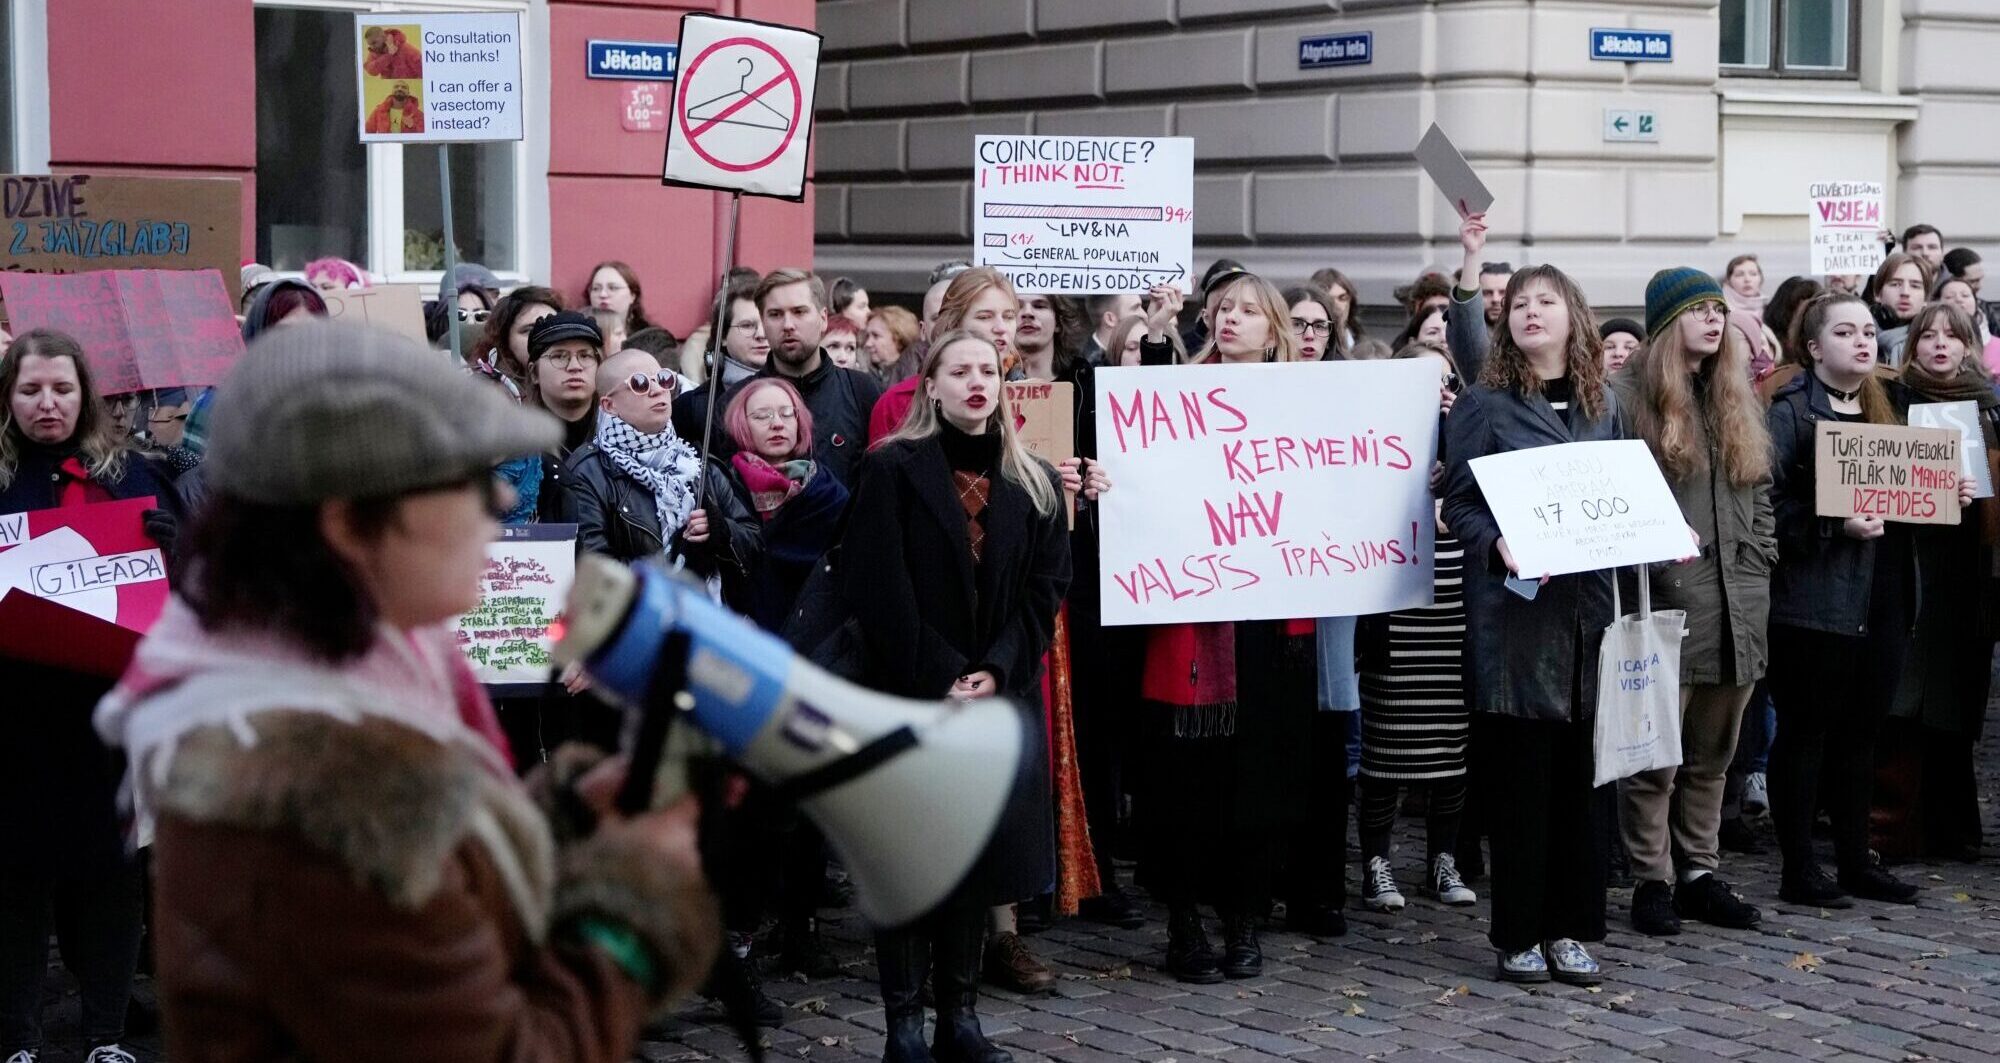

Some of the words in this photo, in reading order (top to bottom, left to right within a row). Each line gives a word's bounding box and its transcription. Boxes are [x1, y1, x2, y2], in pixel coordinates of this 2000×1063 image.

[425, 31, 511, 44] Consultation
[1600, 35, 1643, 54] Jēkaba
[1645, 37, 1667, 54] iela
[425, 51, 445, 62] No
[450, 49, 499, 62] thanks!
[600, 50, 663, 71] Jēkaba
[1302, 41, 1345, 62] Atgriežu
[1346, 40, 1366, 56] iela
[431, 81, 434, 92] I
[439, 84, 464, 93] can
[468, 80, 499, 93] offer
[504, 82, 512, 92] a
[431, 100, 505, 113] vasectomy
[431, 117, 490, 130] instead?
[980, 140, 1155, 163] COINCIDENCE?
[982, 169, 987, 188] I
[996, 164, 1068, 184] THINK
[1074, 163, 1124, 183] NOT.
[1165, 206, 1192, 223] 94%
[1817, 200, 1879, 222] VISIEM
[1814, 235, 1829, 244] NE
[1835, 233, 1863, 242] TIKAI
[1024, 248, 1079, 260] GENERAL
[1084, 248, 1159, 263] POPULATION
[1108, 387, 1248, 452] MANS
[1867, 438, 1902, 458] SAVU
[1838, 459, 1886, 486] TĀLĀK
[1890, 464, 1907, 486] NO
[1911, 464, 1956, 490] MANAS
[1533, 502, 1564, 526] 47
[1581, 497, 1629, 520] 000
[1853, 488, 1937, 518] DZEMDES
[1204, 490, 1284, 547] NAV
[1113, 554, 1260, 604] VALSTS
[1272, 521, 1419, 577] ĪPAŠUMS!
